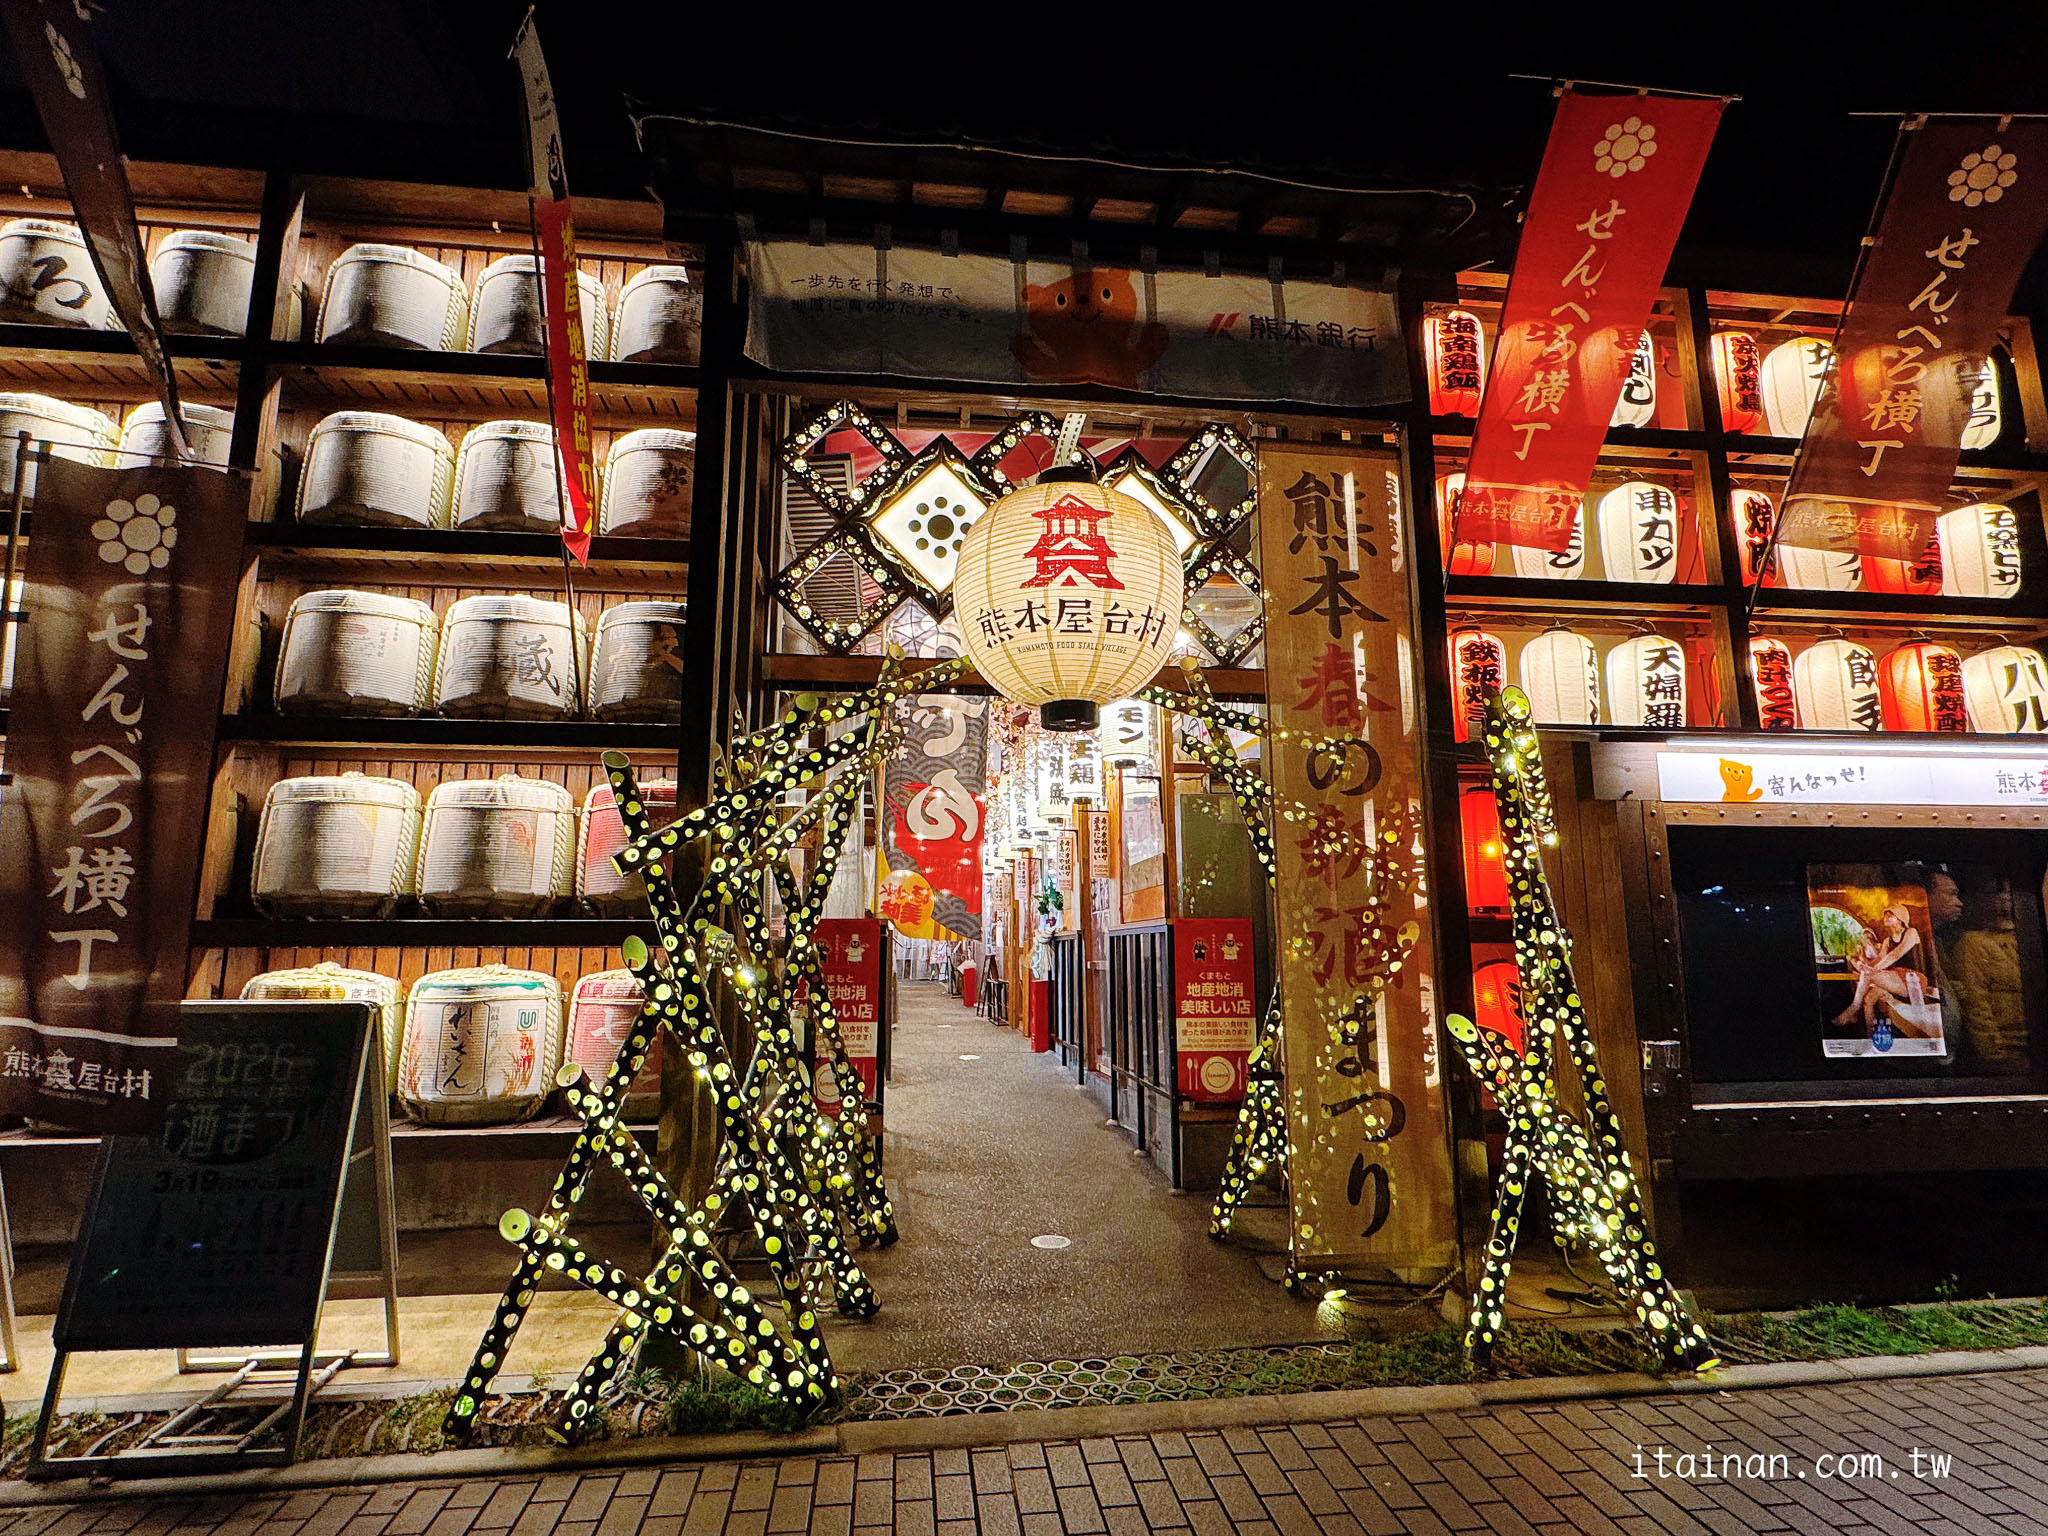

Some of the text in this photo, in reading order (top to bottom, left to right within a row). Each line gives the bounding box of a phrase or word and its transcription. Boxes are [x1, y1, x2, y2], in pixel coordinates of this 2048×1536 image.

[790, 273, 963, 301] 一歩先を行く発想で、
[1249, 314, 1377, 352] 熊本銀行
[1440, 316, 1479, 391] 海南鶏飯
[1511, 199, 1626, 461] せんべろ横丁
[1857, 228, 1979, 477] せんべろ横丁
[1635, 487, 1674, 571] 串カツ
[976, 599, 1167, 650] 熊本屋台村
[1017, 641, 1128, 655] KUMAMOTO FOOD STALL VILLAGE
[1643, 645, 1682, 727] 天婦羅
[1844, 650, 1881, 731] 餃子
[2004, 655, 2048, 733] バル
[47, 603, 153, 991] せんべろ横丁
[1767, 766, 1866, 797] 寄んなっせ!
[1995, 769, 2036, 794] 熊本
[1186, 981, 1244, 997] 地産地消
[1199, 971, 1232, 980] くまもと
[1181, 999, 1251, 1015] 美味しい店
[1, 1044, 152, 1099] 熊本屋台村
